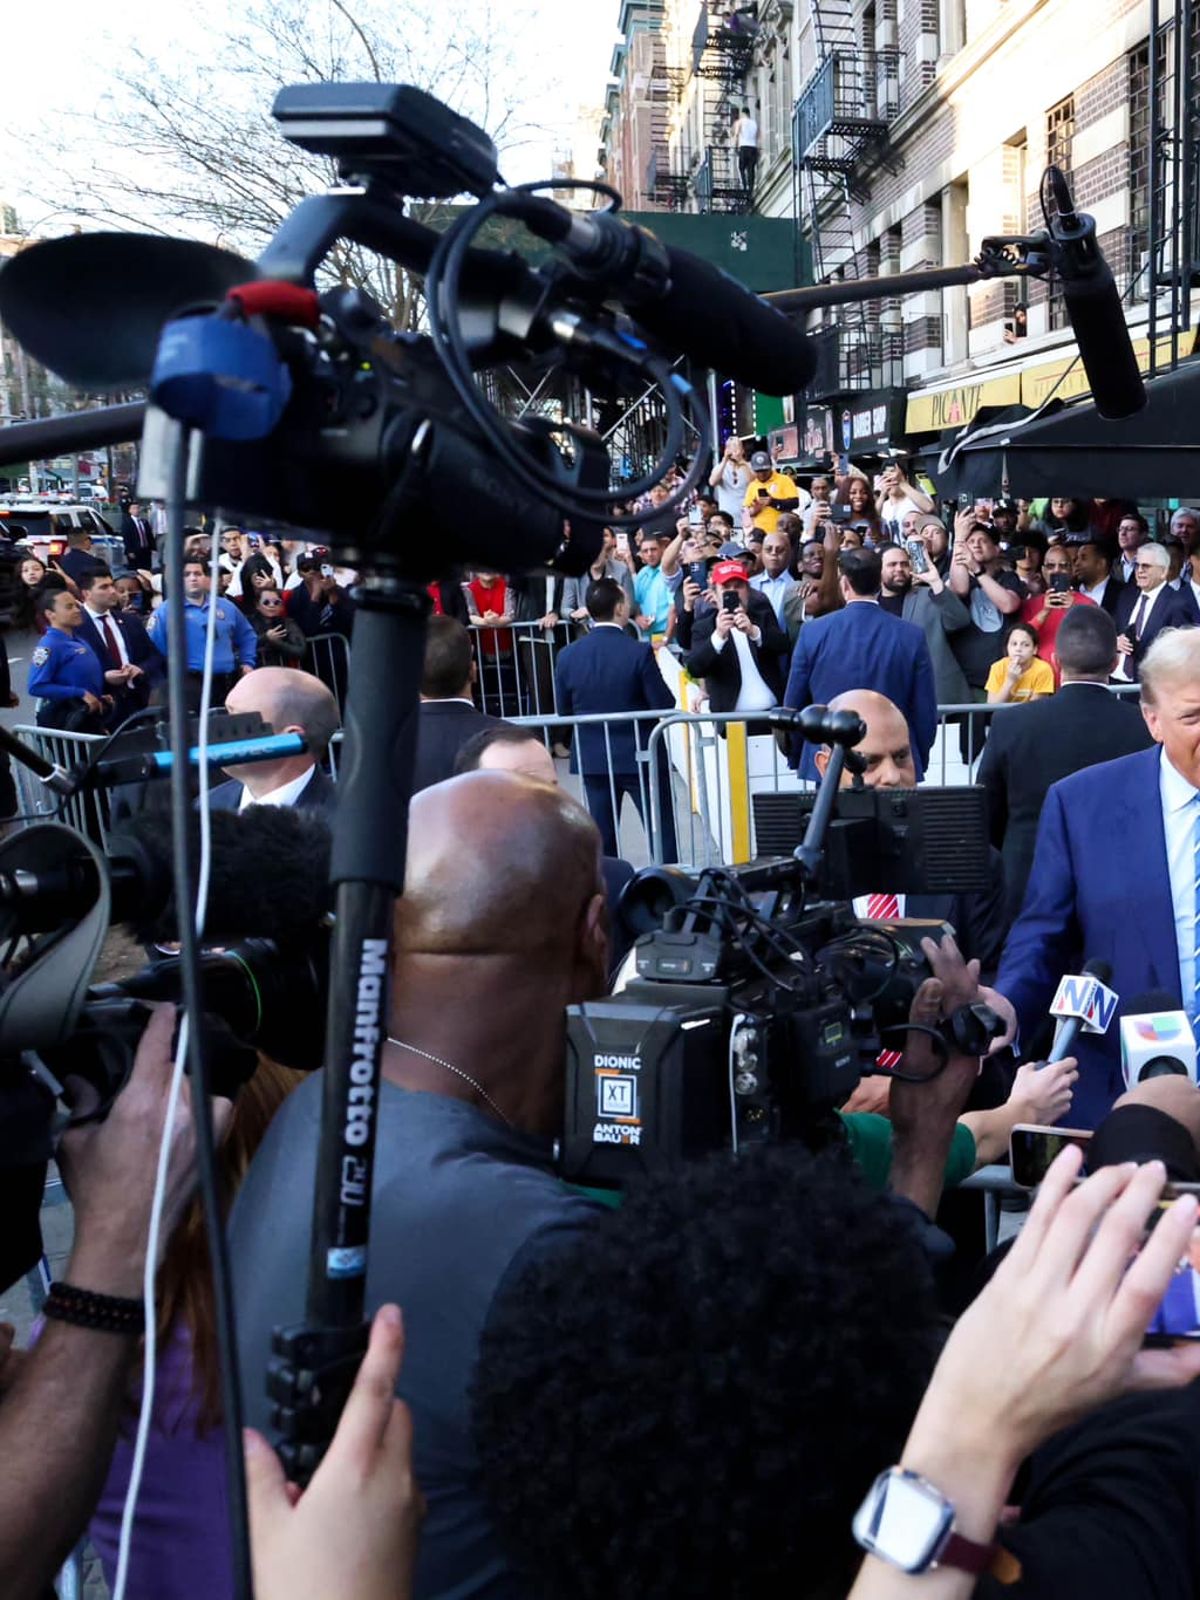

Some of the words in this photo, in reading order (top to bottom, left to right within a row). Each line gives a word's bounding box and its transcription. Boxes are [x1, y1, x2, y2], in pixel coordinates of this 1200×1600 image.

[345, 939, 388, 1147] Manfrotto
[594, 1054, 641, 1070] DIONIC
[608, 1084, 627, 1102] XT
[594, 1122, 640, 1136] ANTON
